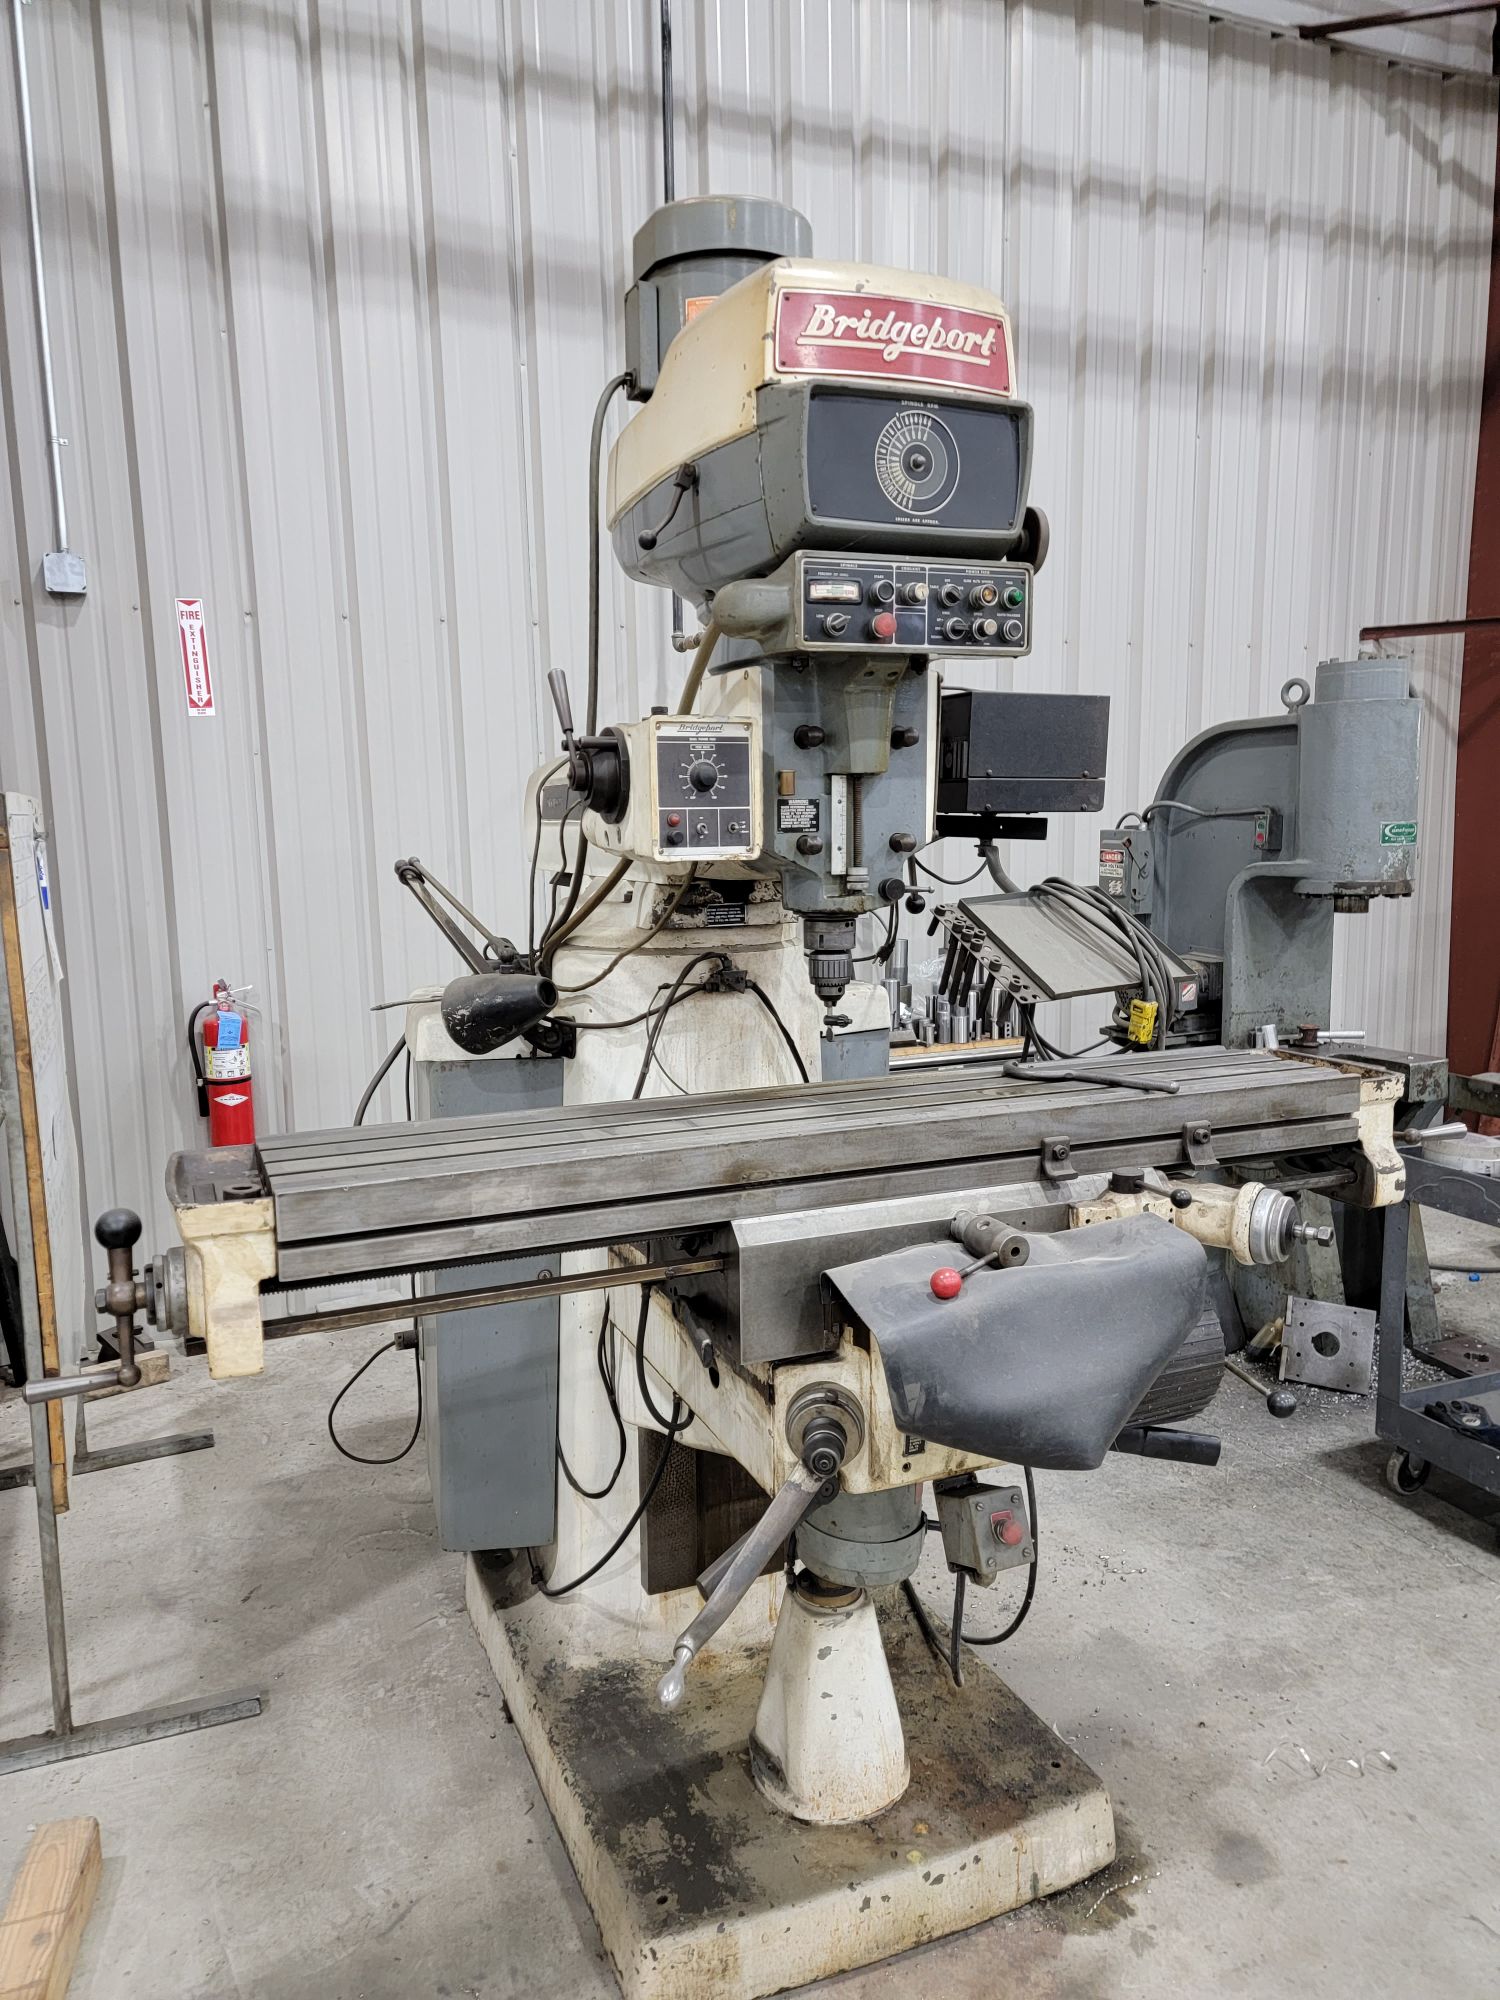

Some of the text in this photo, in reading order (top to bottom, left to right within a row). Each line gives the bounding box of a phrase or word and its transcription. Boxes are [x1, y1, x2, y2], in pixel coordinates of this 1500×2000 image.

[800, 304, 996, 362] Bridgeport
[180, 610, 201, 621] FIRE
[188, 624, 204, 703] EXTINGUISHER
[677, 724, 724, 735] Bridgeport
